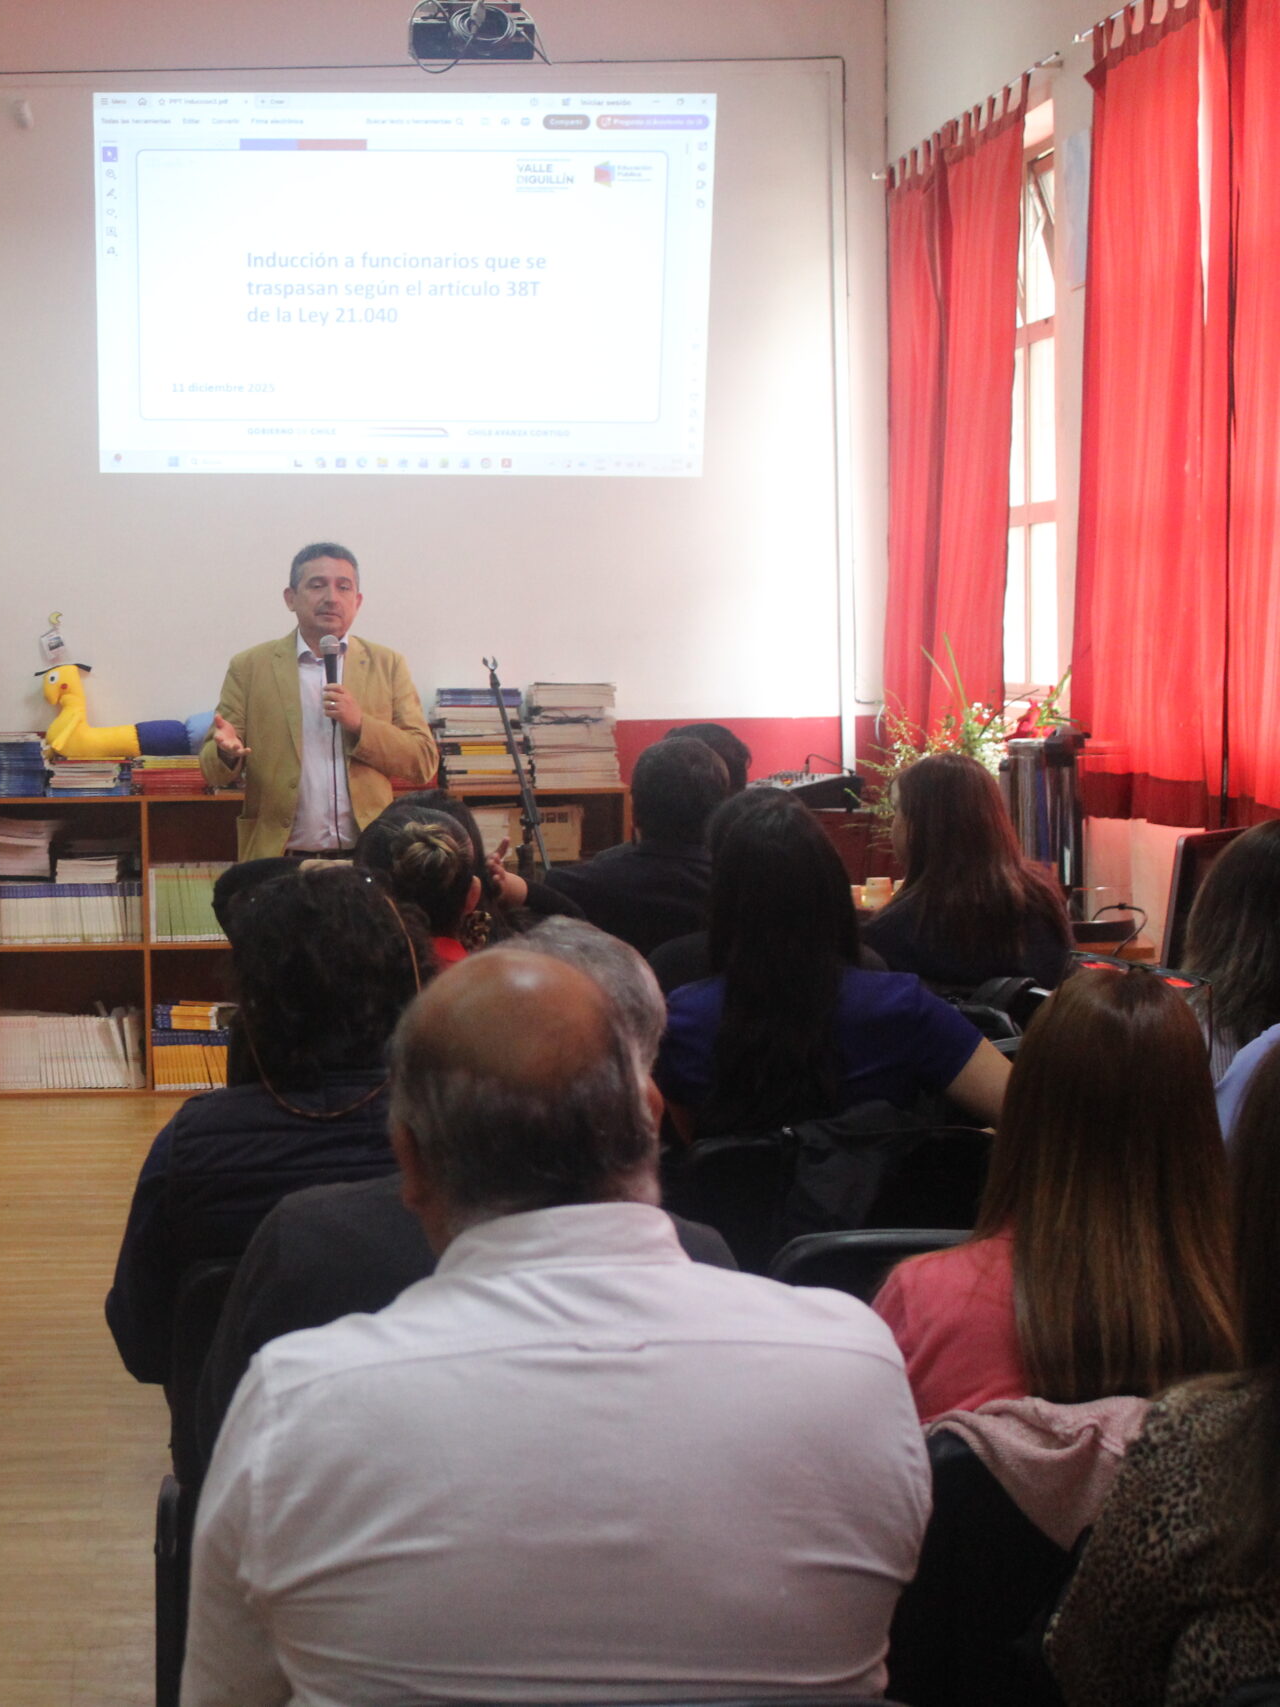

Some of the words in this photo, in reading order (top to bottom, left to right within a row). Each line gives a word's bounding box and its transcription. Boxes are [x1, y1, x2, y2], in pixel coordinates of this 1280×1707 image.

[581, 98, 604, 106] Iniciar
[516, 163, 553, 173] VALLE
[516, 173, 575, 185] DIGUILLÍN
[247, 251, 338, 269] Inducción
[344, 256, 355, 269] a
[361, 251, 480, 269] funcionarios
[484, 256, 520, 272] que
[526, 256, 547, 269] se
[247, 281, 338, 299] traspasan
[344, 279, 399, 300] según
[406, 279, 421, 296] el
[428, 279, 500, 297] artículo
[506, 280, 542, 297] 38T
[247, 306, 270, 323] de
[276, 306, 292, 323] la
[299, 306, 329, 327] Ley
[335, 306, 399, 323] 21.040
[172, 382, 185, 393] 11
[188, 382, 245, 393] diciembre
[247, 427, 294, 436] GOBIERNO
[310, 427, 337, 436] CHILE
[531, 429, 572, 437] CONTIGO
